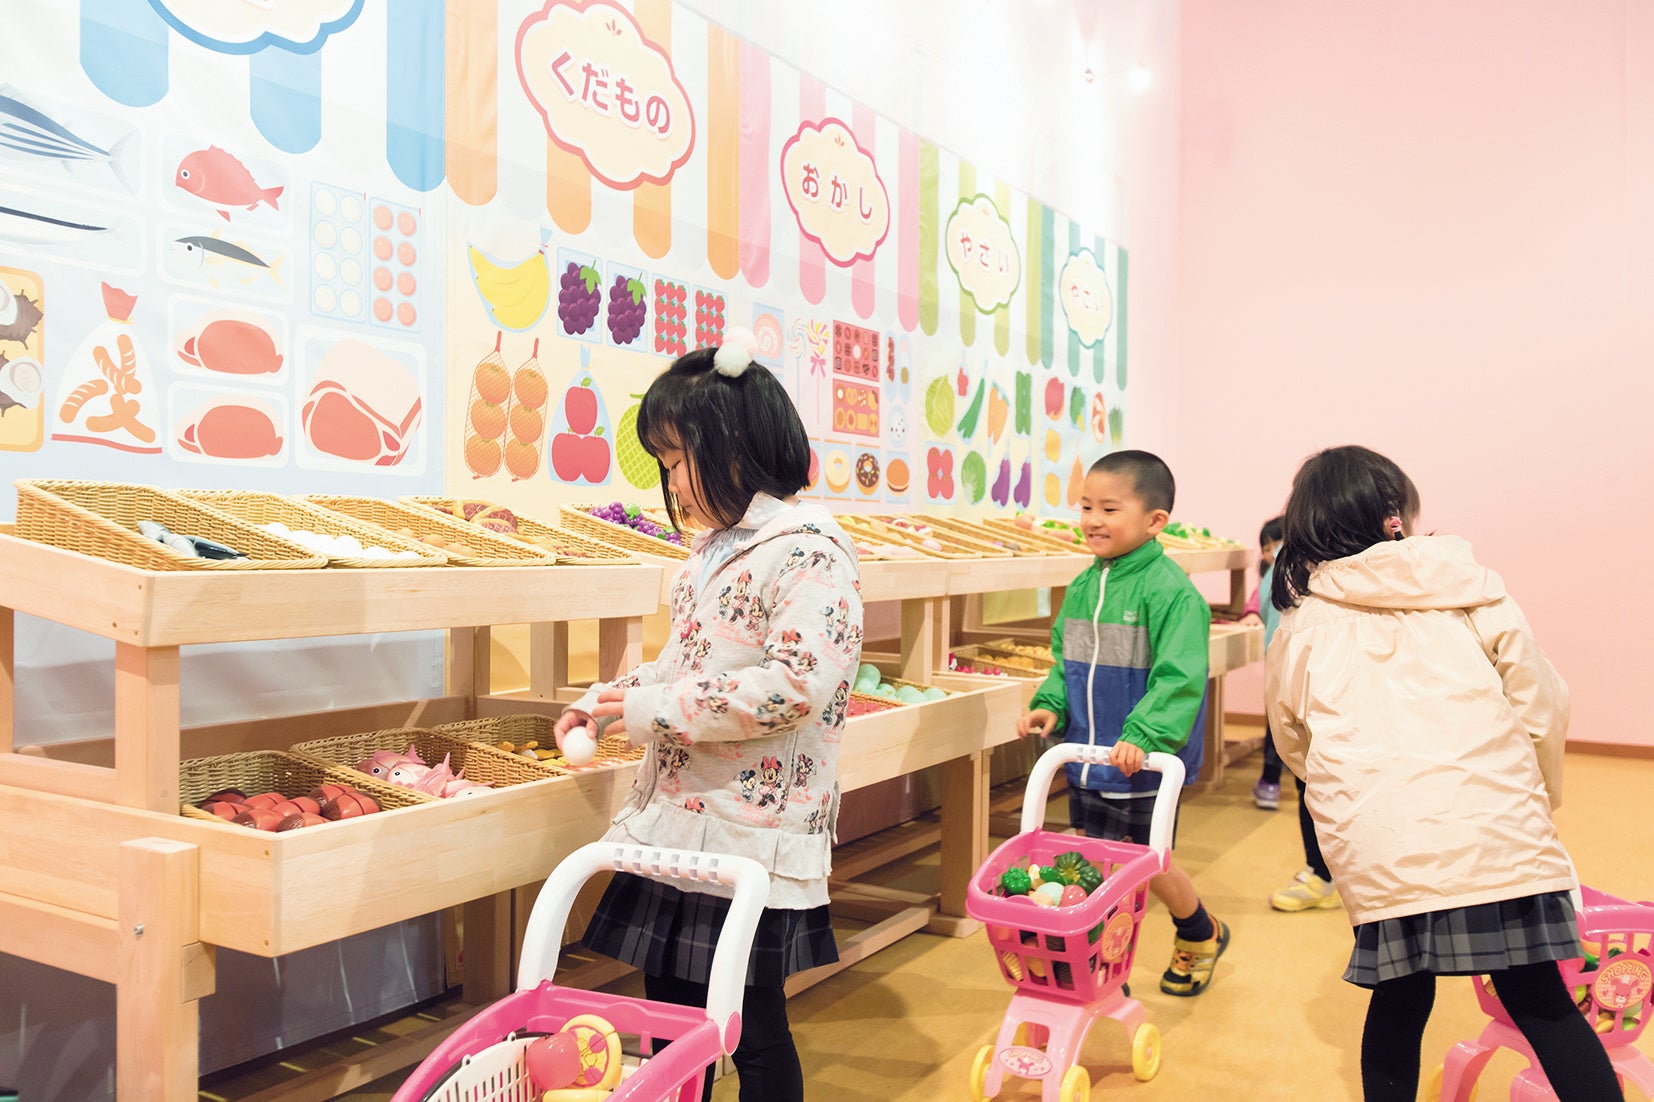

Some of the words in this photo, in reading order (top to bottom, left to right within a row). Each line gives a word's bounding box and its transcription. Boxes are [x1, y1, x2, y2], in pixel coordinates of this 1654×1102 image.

[551, 51, 671, 134] くだもの
[801, 163, 873, 220] おかし
[960, 232, 1009, 273] やさい
[1601, 962, 1648, 982] SHOPPING
